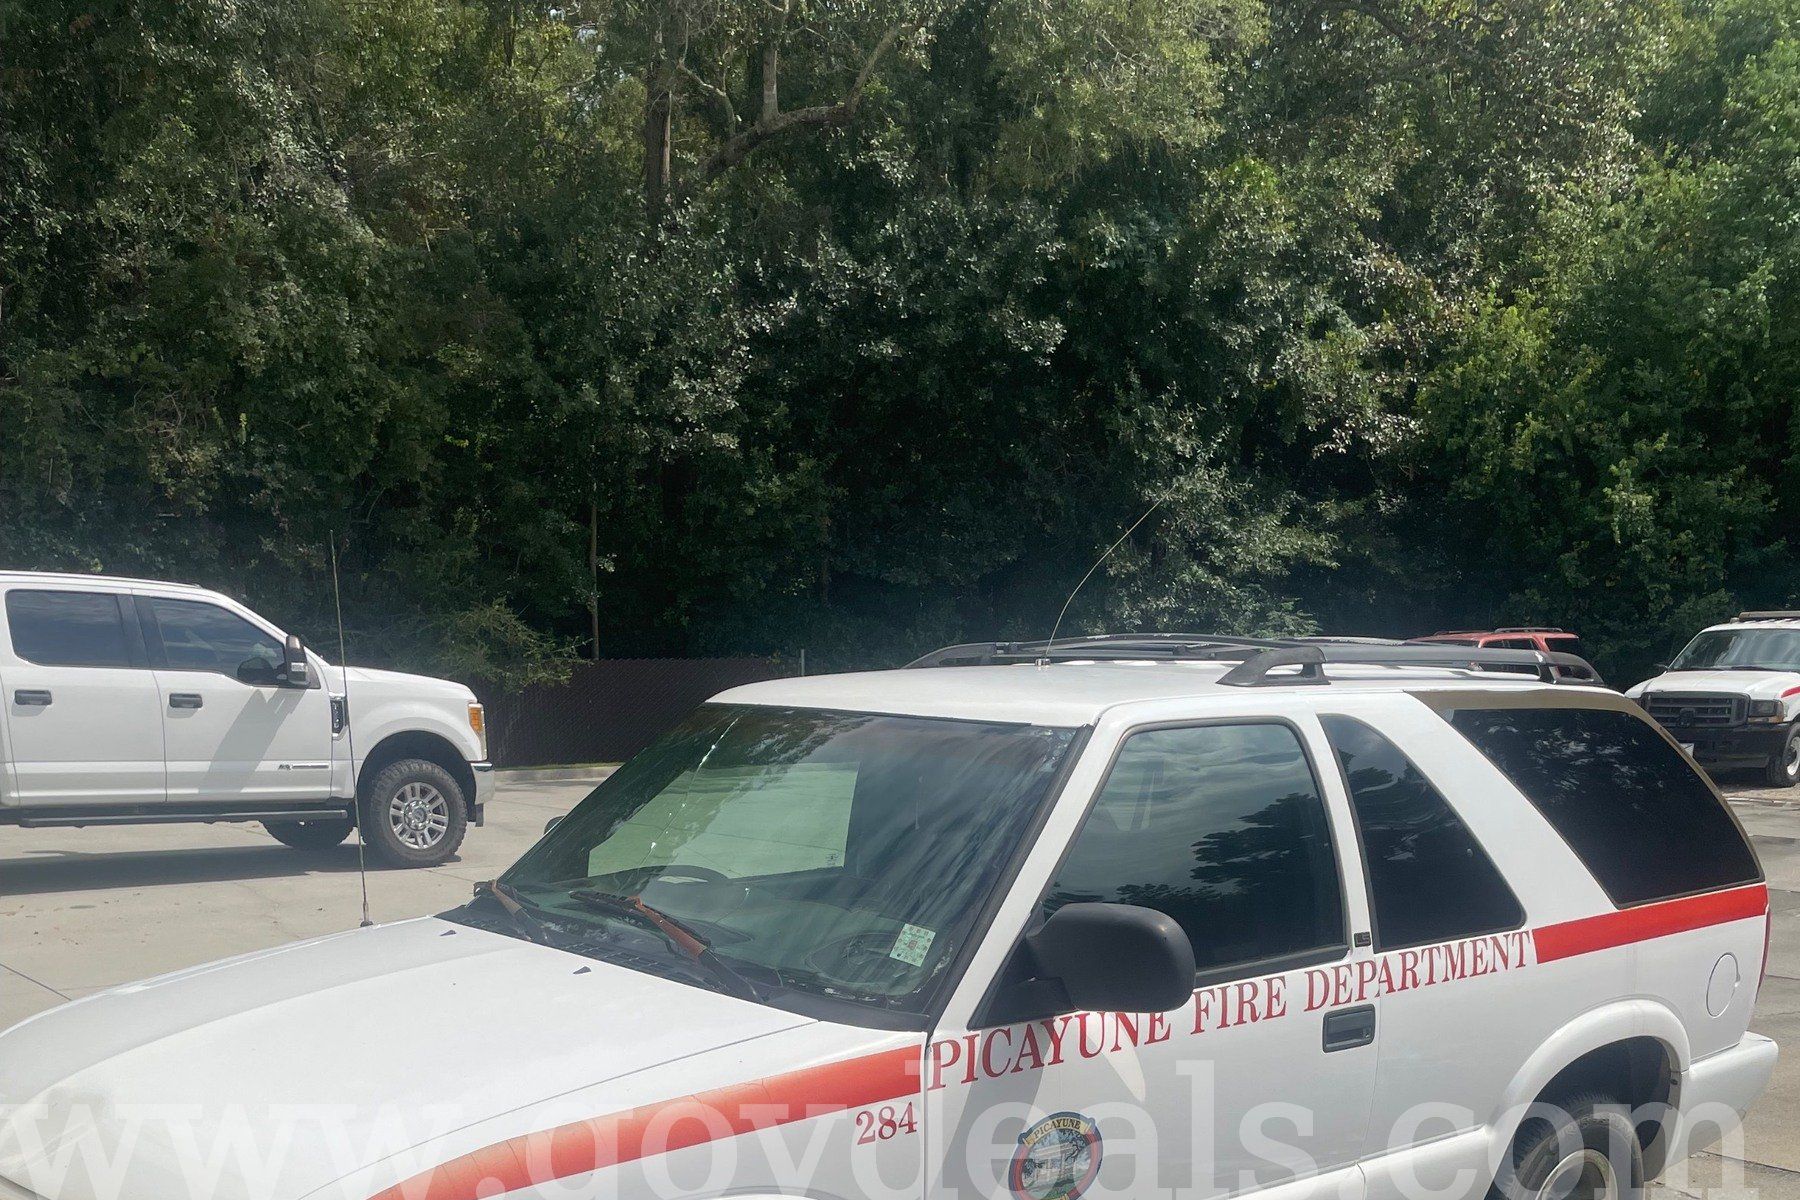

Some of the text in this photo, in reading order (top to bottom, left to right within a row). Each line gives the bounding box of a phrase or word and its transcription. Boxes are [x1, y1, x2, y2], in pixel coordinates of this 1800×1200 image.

[927, 931, 1531, 1091] PICAYUNE FIRE DEPARTMENT
[856, 1101, 918, 1146] 284
[1034, 1118, 1082, 1139] PICAYUNE
